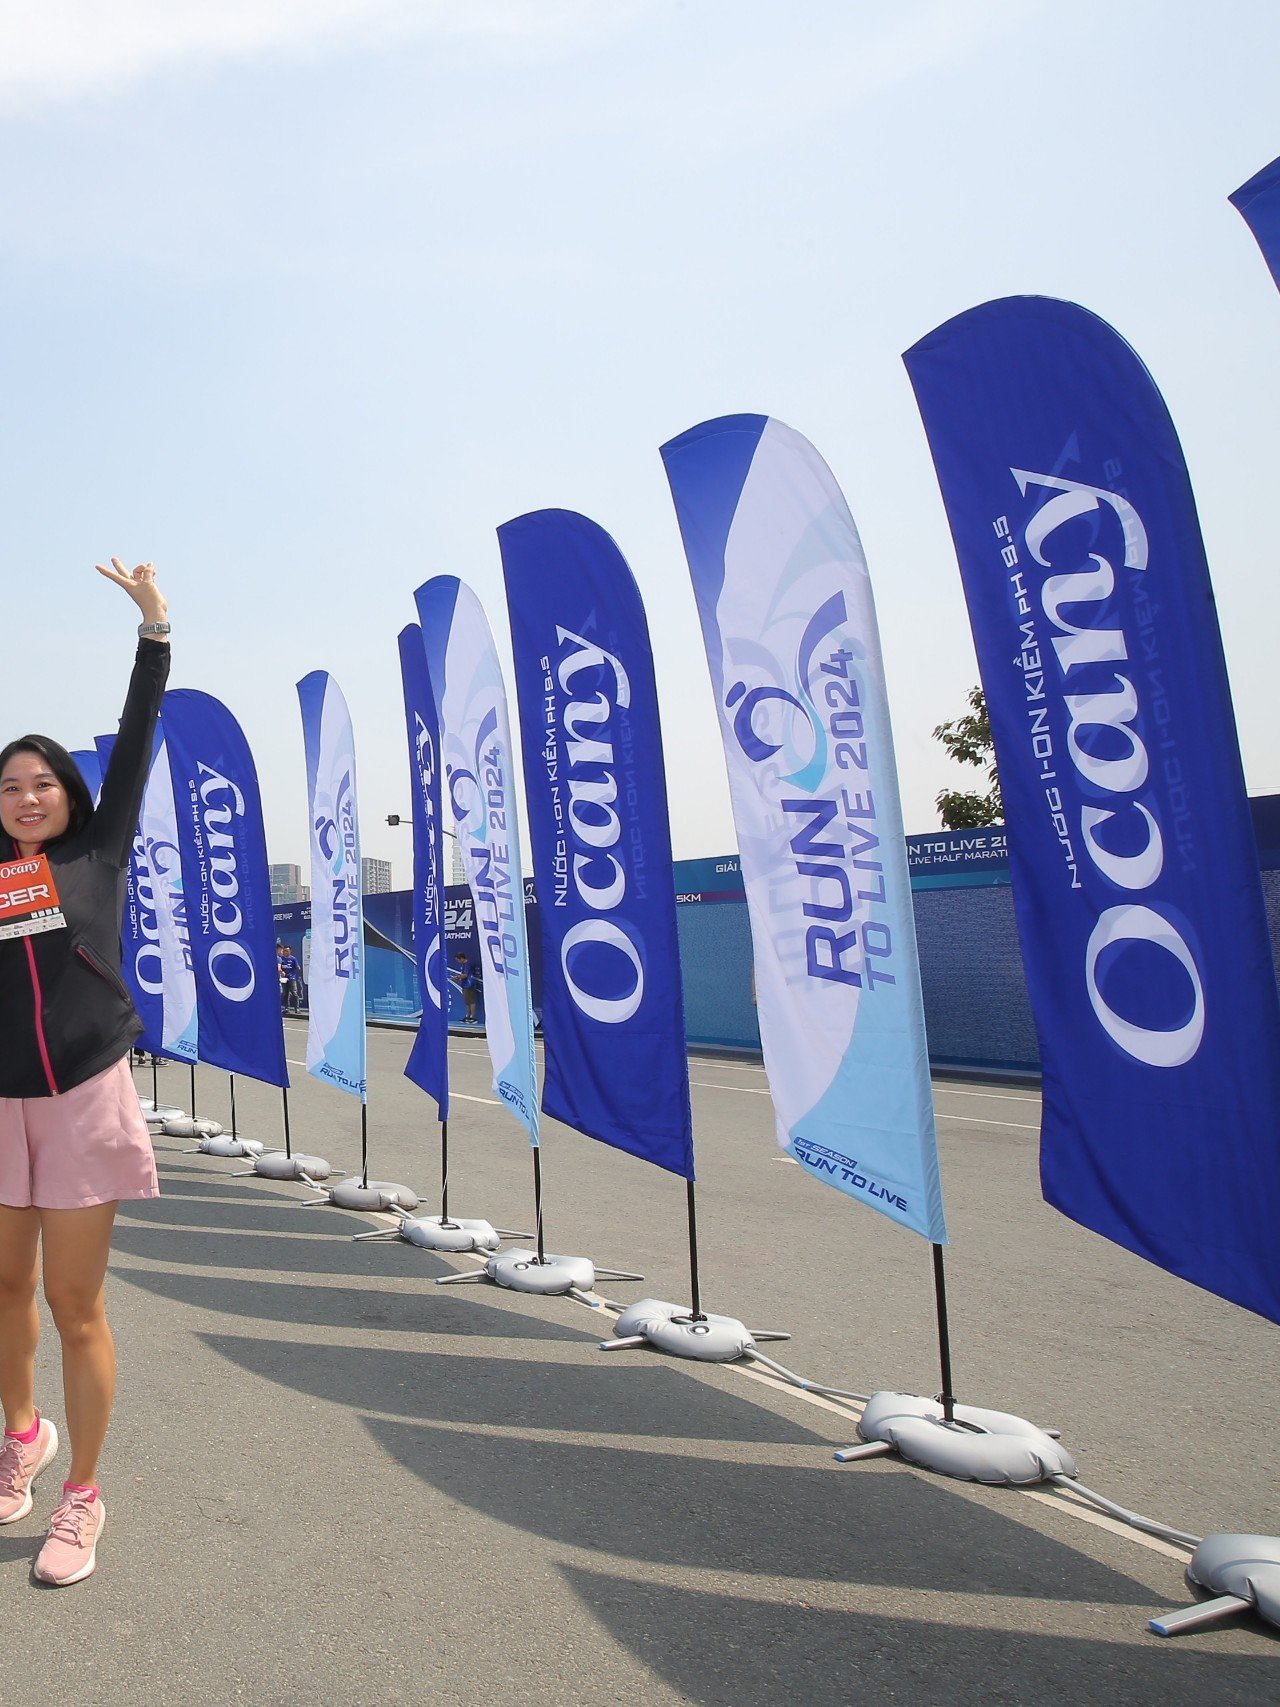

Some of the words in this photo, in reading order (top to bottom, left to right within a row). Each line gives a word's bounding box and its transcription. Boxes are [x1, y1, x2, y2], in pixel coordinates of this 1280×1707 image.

[992, 515, 1019, 568] 9.5
[1010, 571, 1032, 615] PH
[540, 655, 555, 692] 9.5
[1013, 620, 1045, 702] KIỀM
[544, 695, 556, 724] PH
[819, 648, 869, 770] 2024
[1009, 467, 1205, 1068] Ocany
[1028, 707, 1057, 780] I-ON
[191, 804, 200, 822] PH
[484, 746, 508, 831] 2024
[551, 787, 564, 835] I-ON
[342, 800, 357, 864] 2024
[556, 624, 644, 1024] Ocany
[841, 788, 887, 904] LIVE
[924, 842, 946, 854] TO
[950, 837, 987, 852] LIVE
[1045, 787, 1083, 889] NƯỚC
[0, 861, 41, 879] Ocany
[197, 761, 256, 1002] Ocany
[199, 861, 208, 891] I-ON
[490, 842, 515, 922] LIVE
[552, 840, 568, 907] NƯỚC
[715, 861, 738, 873] GIẢI
[909, 856, 932, 866] LIVE
[933, 853, 963, 863] HALF
[964, 849, 1009, 861] MARAT
[132, 830, 164, 995] Ocan
[449, 899, 472, 909] LIVE
[781, 799, 864, 989] RUN
[333, 879, 350, 979] RUN
[502, 933, 520, 980] TO
[862, 920, 896, 991] TO
[795, 1147, 838, 1175] RUN
[841, 1168, 867, 1189] TO
[868, 1182, 908, 1212] LIVE
[810, 1143, 856, 1169] SEASON
